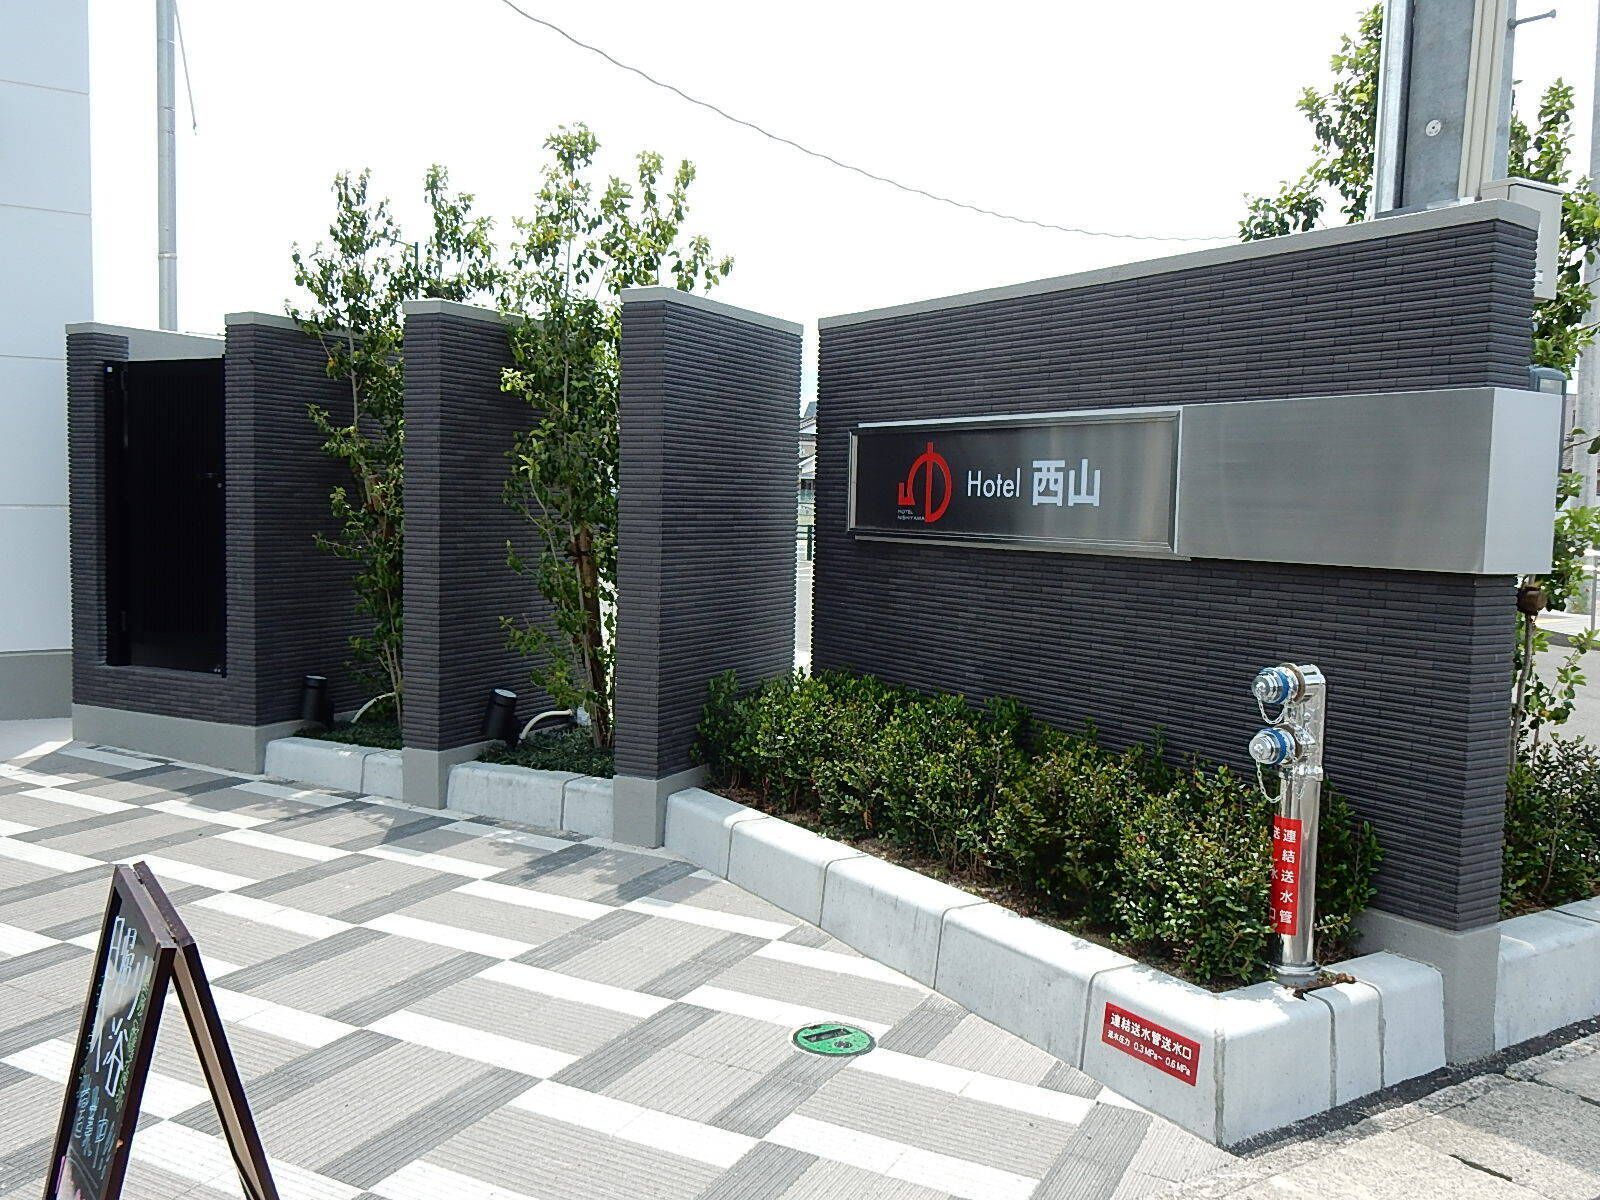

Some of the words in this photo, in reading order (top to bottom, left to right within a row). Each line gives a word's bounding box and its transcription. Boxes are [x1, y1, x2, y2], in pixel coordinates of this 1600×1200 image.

[967, 467, 1021, 498] Hotel
[1031, 458, 1101, 507] 西山
[1280, 829, 1297, 924] 連結送水管
[1110, 1012, 1192, 1061] 連結送水管送水口
